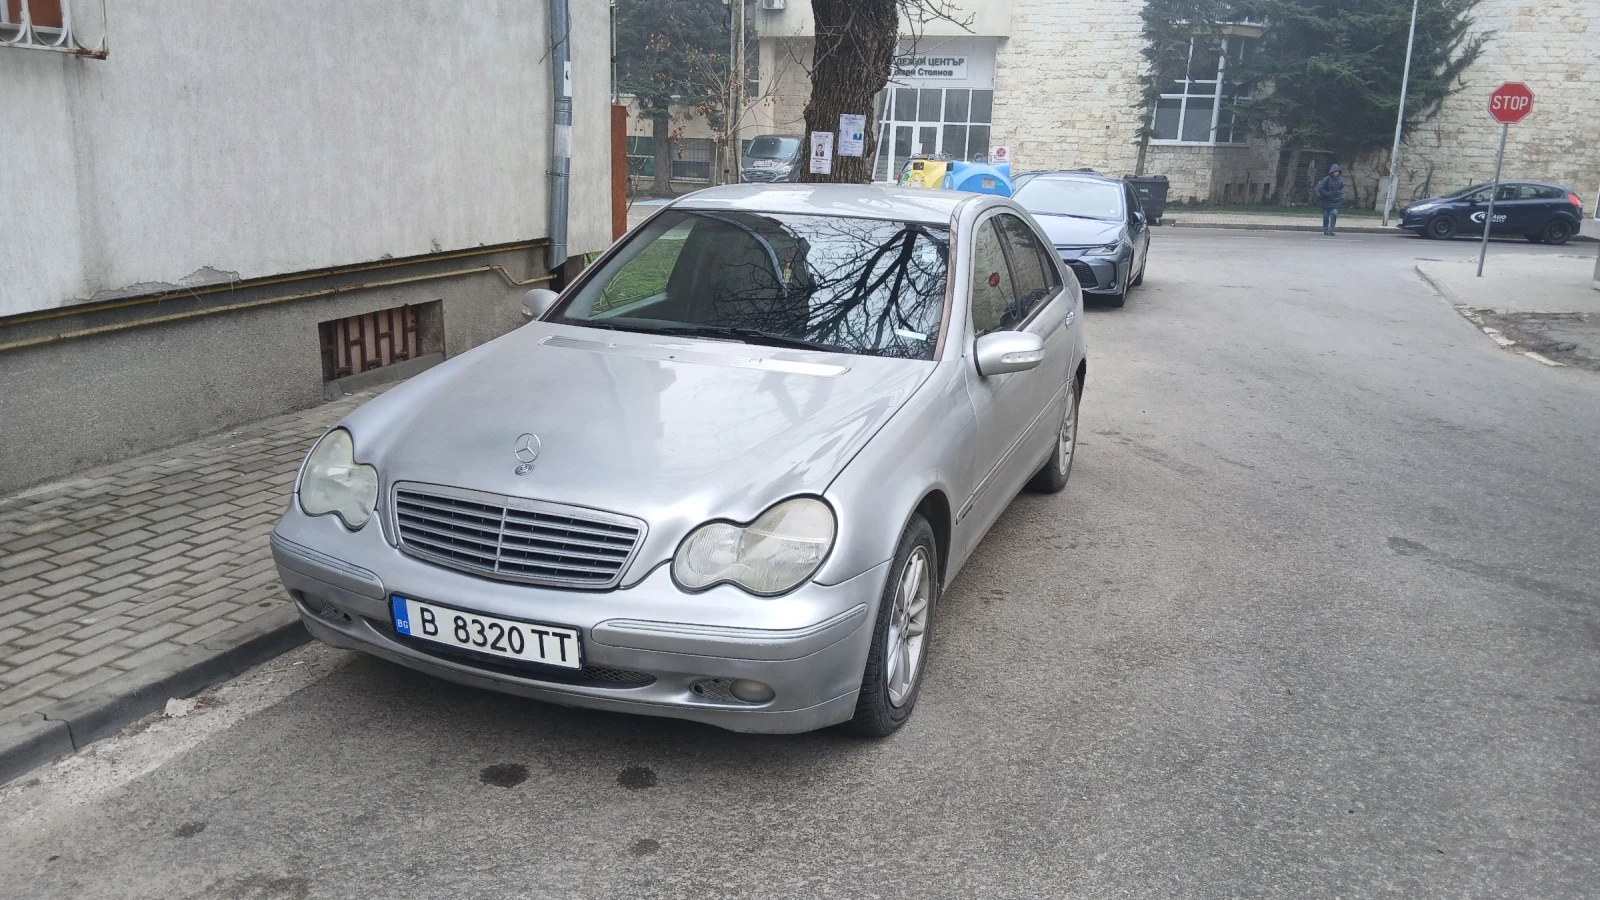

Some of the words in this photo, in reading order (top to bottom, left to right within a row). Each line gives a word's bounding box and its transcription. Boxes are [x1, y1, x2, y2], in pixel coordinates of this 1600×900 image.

[928, 58, 964, 66] ЦЕНТЪР
[918, 68, 954, 76] Стоянов
[1492, 95, 1529, 110] STOP
[397, 618, 409, 629] BG
[420, 606, 439, 636] B
[453, 615, 525, 654] 8320
[531, 628, 571, 662] TT
